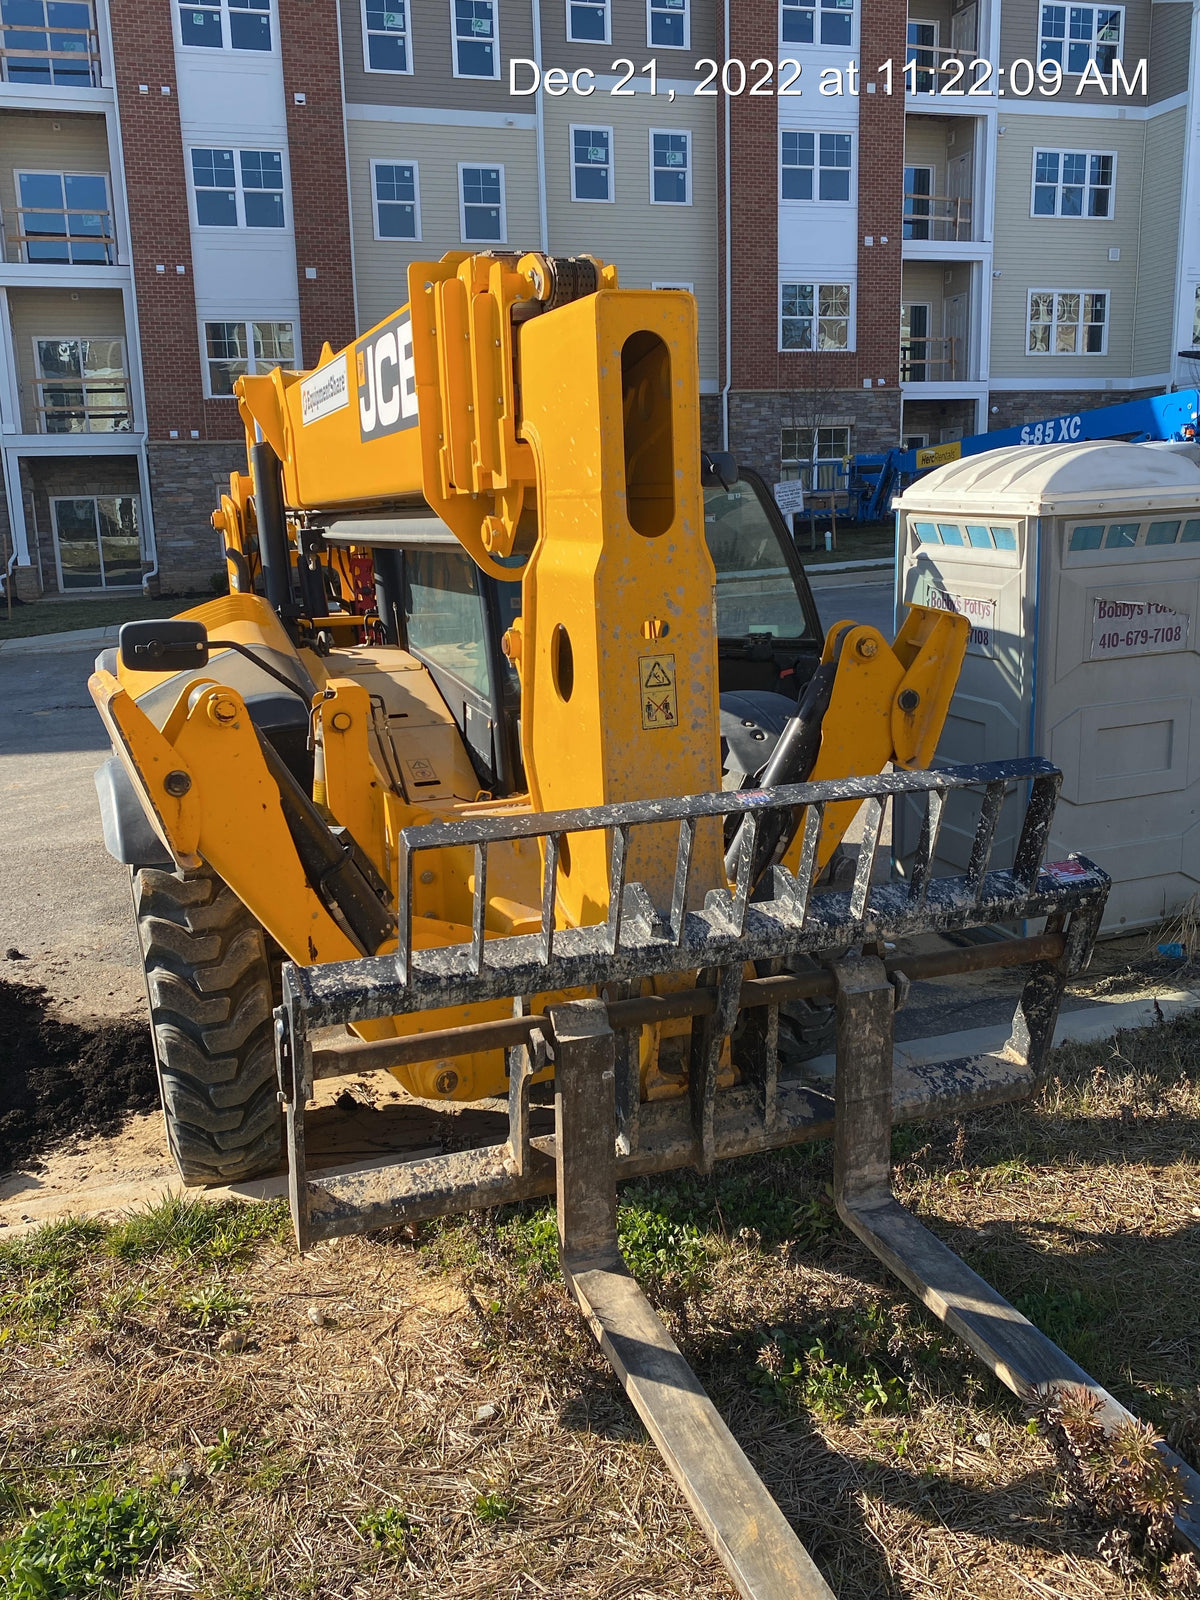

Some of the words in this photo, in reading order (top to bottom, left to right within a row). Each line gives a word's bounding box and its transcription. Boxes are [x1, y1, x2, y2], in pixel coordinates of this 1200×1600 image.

[360, 320, 418, 432] JCB
[1020, 421, 1055, 446] S-85
[1058, 416, 1081, 442] XC
[1098, 599, 1144, 620] Bobbys
[1099, 625, 1182, 649] 410-679-7108
